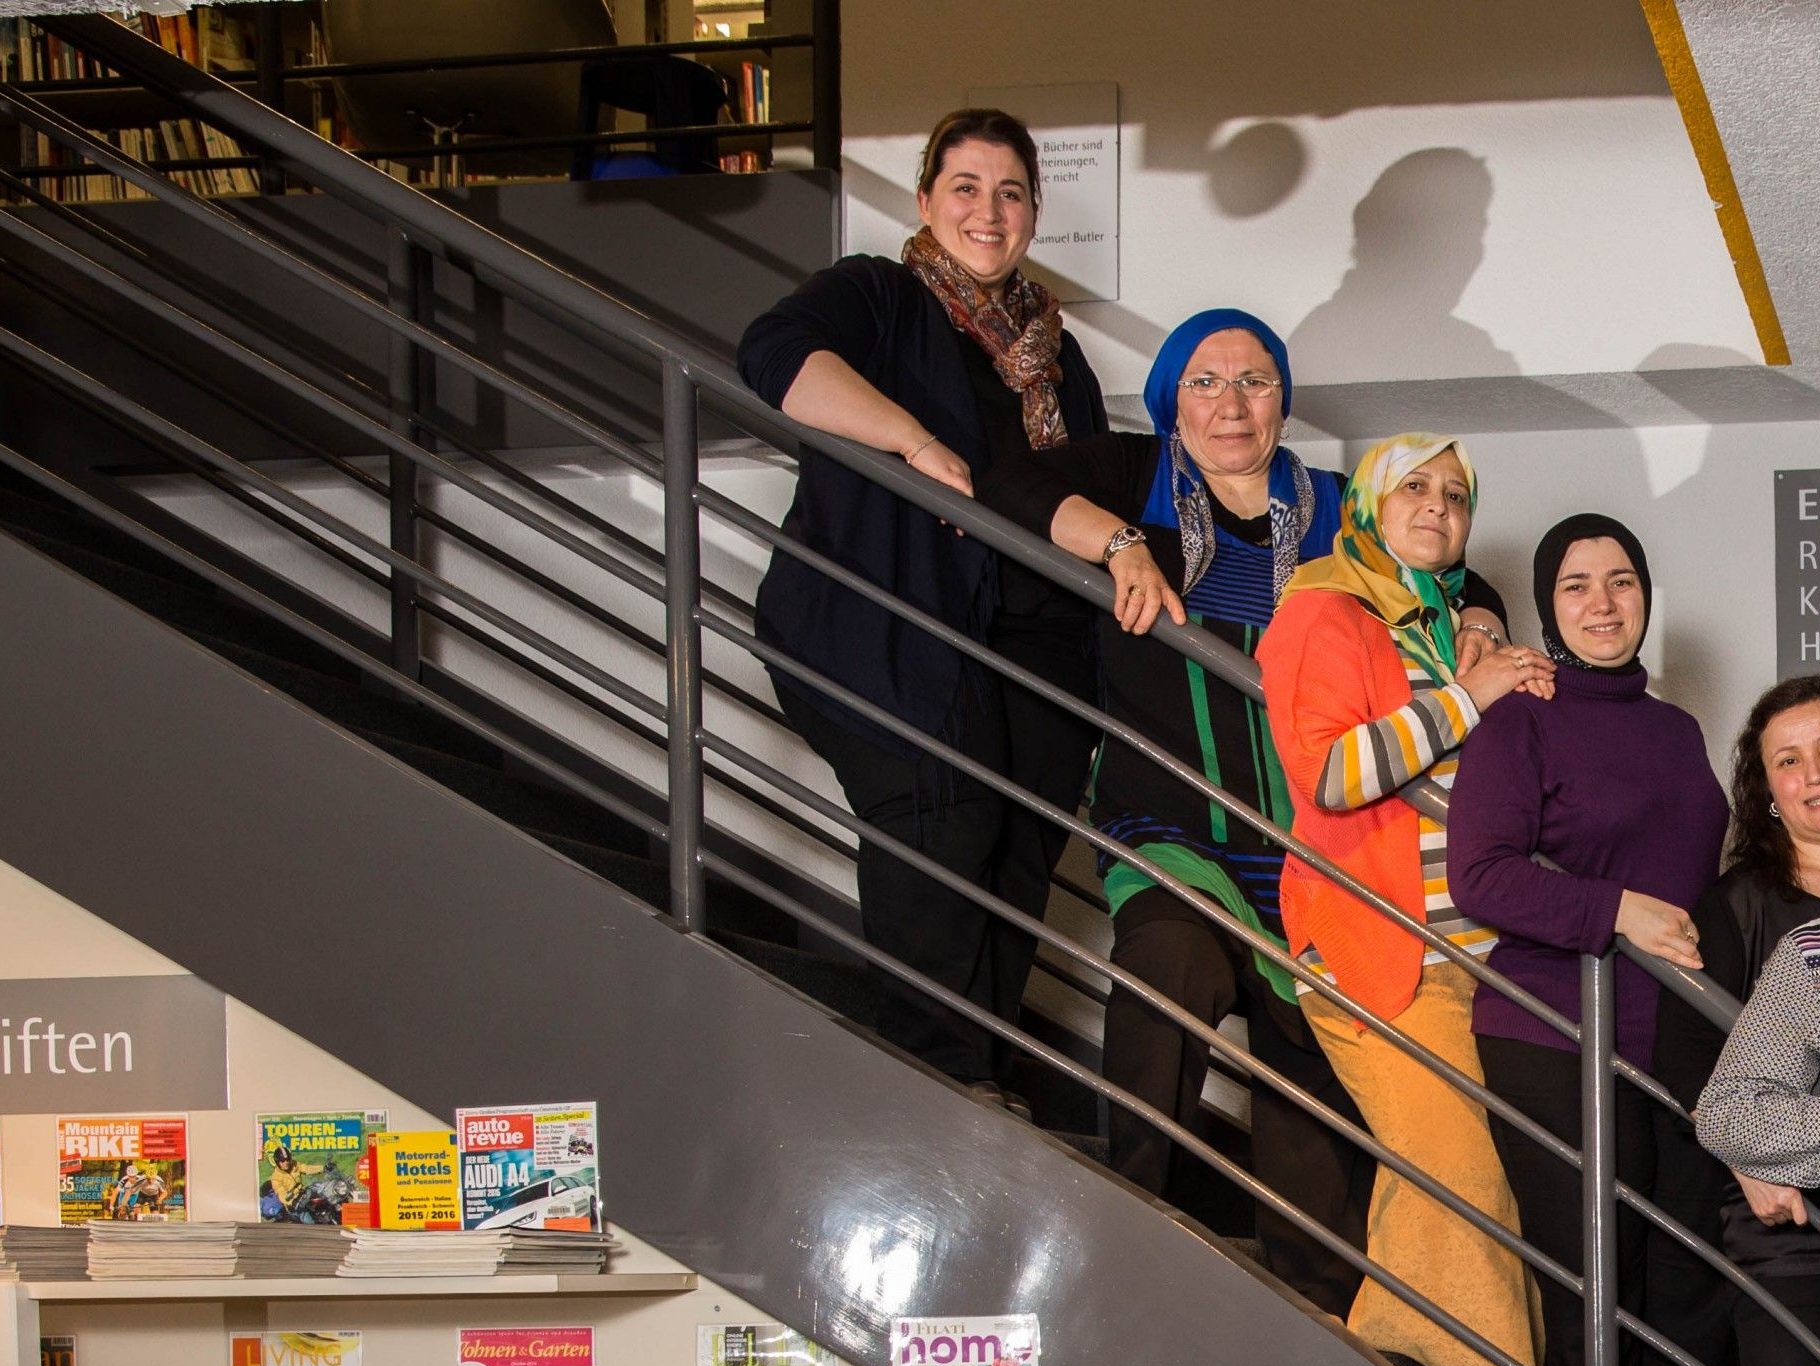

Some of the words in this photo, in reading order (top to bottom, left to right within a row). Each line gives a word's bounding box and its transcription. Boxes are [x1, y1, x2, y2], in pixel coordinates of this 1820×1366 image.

[1043, 141, 1079, 153] Bücher
[1081, 139, 1103, 151] sind
[1053, 171, 1079, 182] nicht
[1034, 232, 1070, 245] Samuel
[1073, 231, 1105, 243] Butler
[65, 1122, 139, 1136] Mountain
[264, 1122, 342, 1138] TOUREN-
[466, 1117, 511, 1134] auto
[290, 1136, 359, 1151] FAHRER
[467, 1131, 524, 1147] revue
[65, 1135, 140, 1158] BIKE
[395, 1150, 451, 1161] Motorrad-
[396, 1162, 452, 1176] Hotels
[464, 1163, 503, 1189] AUDI
[507, 1162, 530, 1187] A4
[398, 1211, 424, 1220] 2015
[431, 1210, 456, 1219] 2016
[528, 1339, 590, 1358] Garten
